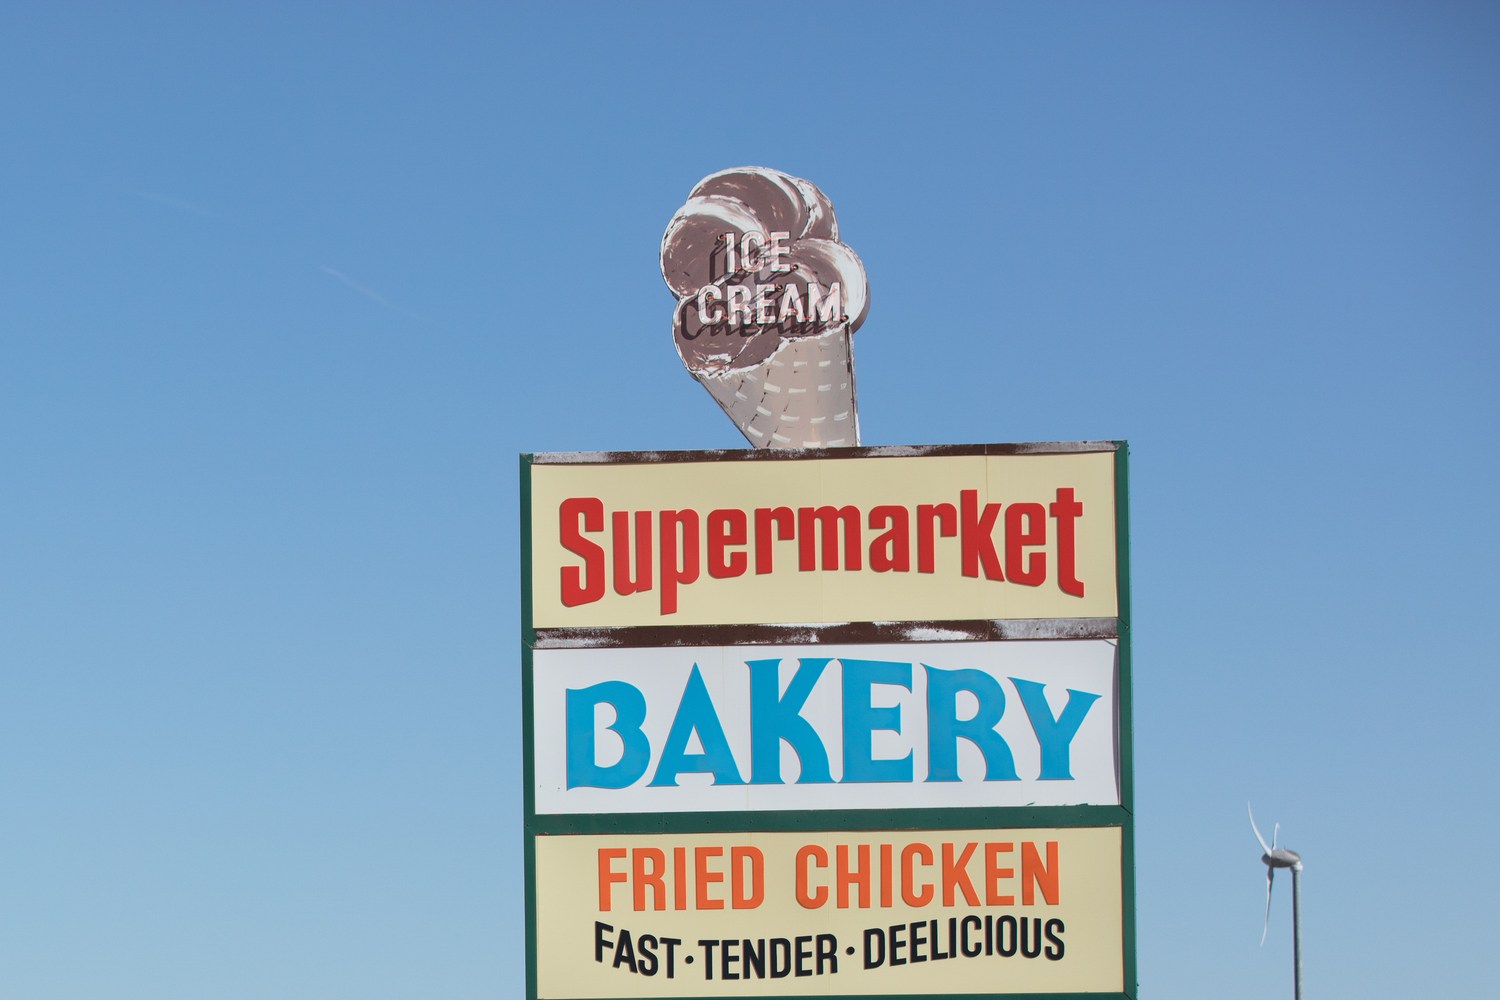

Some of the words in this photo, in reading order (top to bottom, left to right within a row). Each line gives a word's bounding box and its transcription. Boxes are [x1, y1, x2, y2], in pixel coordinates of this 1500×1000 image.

[726, 231, 791, 273] ICE
[698, 282, 842, 325] CREAM
[559, 487, 1085, 615] Supermarket
[566, 657, 1103, 791] BAKERY
[597, 845, 765, 912] FRIED
[795, 840, 1061, 909] CHICKEN
